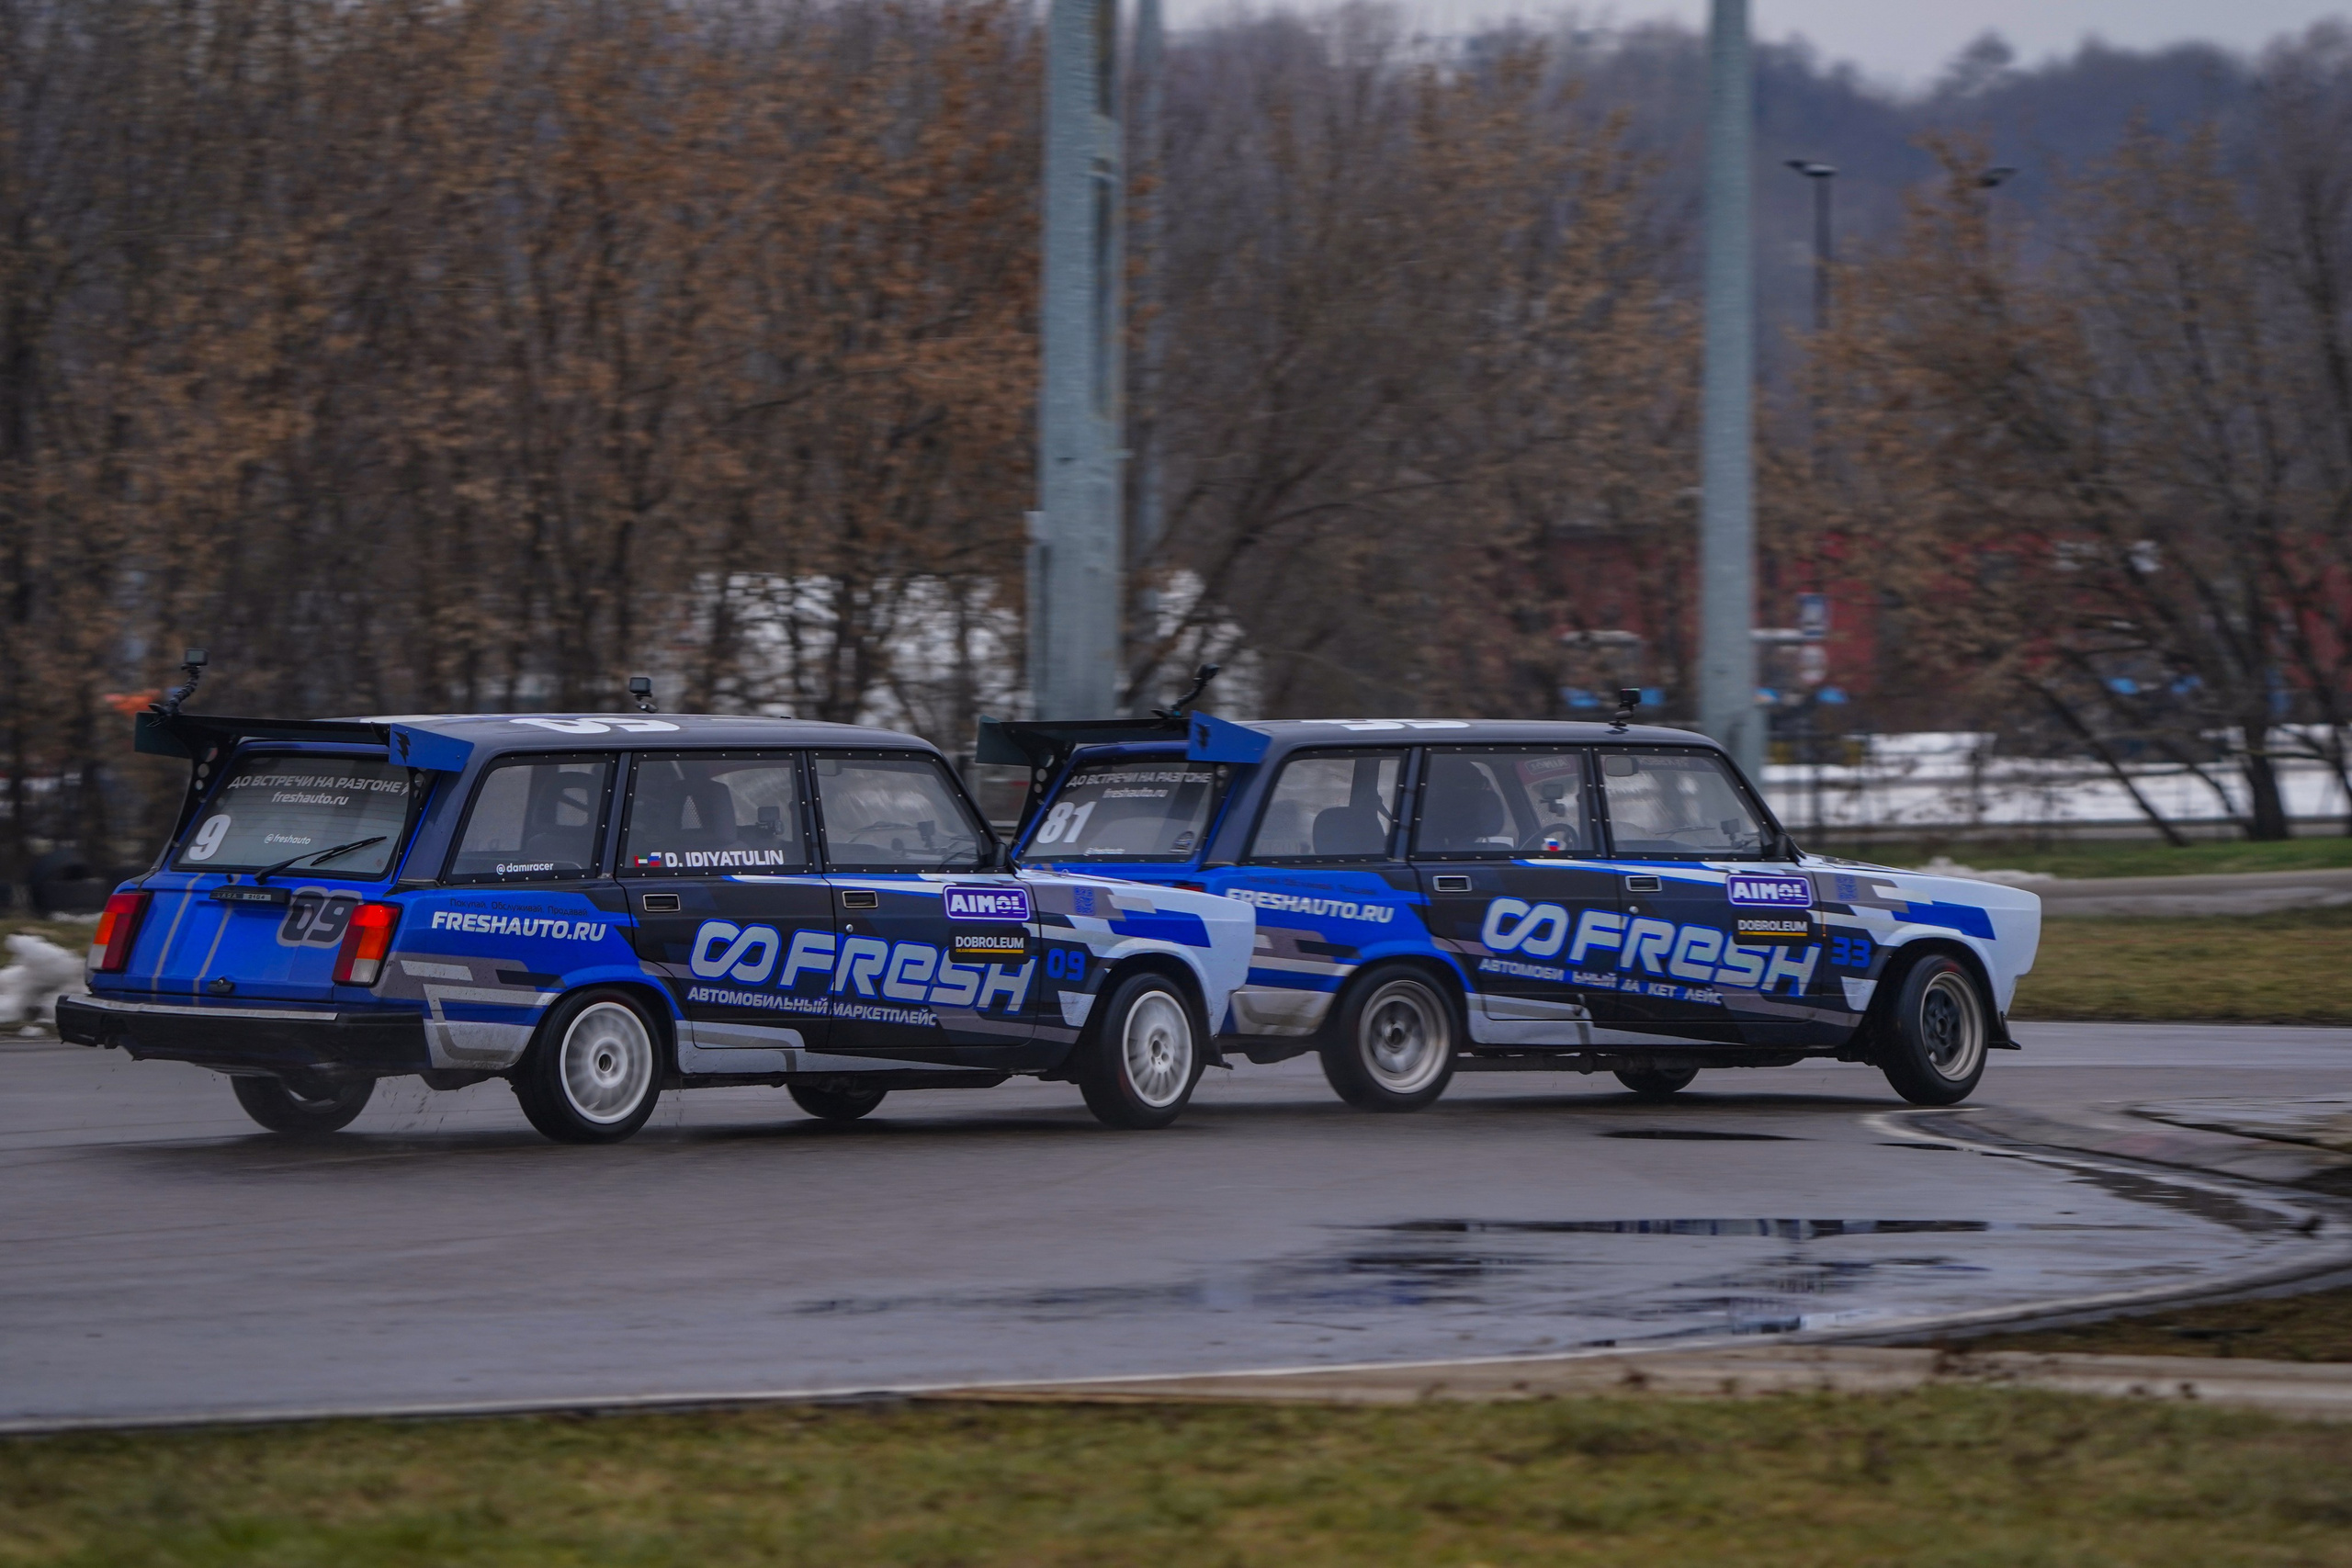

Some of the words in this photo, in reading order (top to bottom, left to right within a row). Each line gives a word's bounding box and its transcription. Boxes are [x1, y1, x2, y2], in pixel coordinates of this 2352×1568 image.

[228, 775, 252, 789] ДО
[252, 774, 316, 786] ВСТРЕЧИ
[316, 776, 334, 788] НА
[334, 777, 401, 793] РАЗГОНЕ
[1066, 774, 1087, 787] ДО
[272, 791, 349, 806] freshauto.ru
[1036, 801, 1097, 844] 81
[188, 814, 231, 861] 9
[265, 833, 311, 845] @freshauto
[496, 862, 554, 874] @damiracer
[664, 852, 684, 868] D.
[684, 850, 785, 867] IDIYATULIN
[1733, 881, 1807, 901] AIMOL
[548, 905, 588, 917] Продавай
[950, 894, 1026, 914] AIMOL
[1226, 887, 1395, 923] FRESHAUTO.RU
[279, 888, 360, 945] 09
[432, 911, 606, 942] FRESHAUTO.RU
[1737, 919, 1808, 932] DOBROLEUM
[955, 936, 1024, 949] DOBROLEUM
[1831, 935, 1871, 967] 33
[1046, 948, 1086, 981] 09
[1478, 958, 1617, 988] АВТОМОБИЬНЫЙ
[687, 987, 828, 1015] АВТОМОБИЛЬНЫЙ
[830, 1002, 938, 1027] МАРКЕТПЛЕЙС
